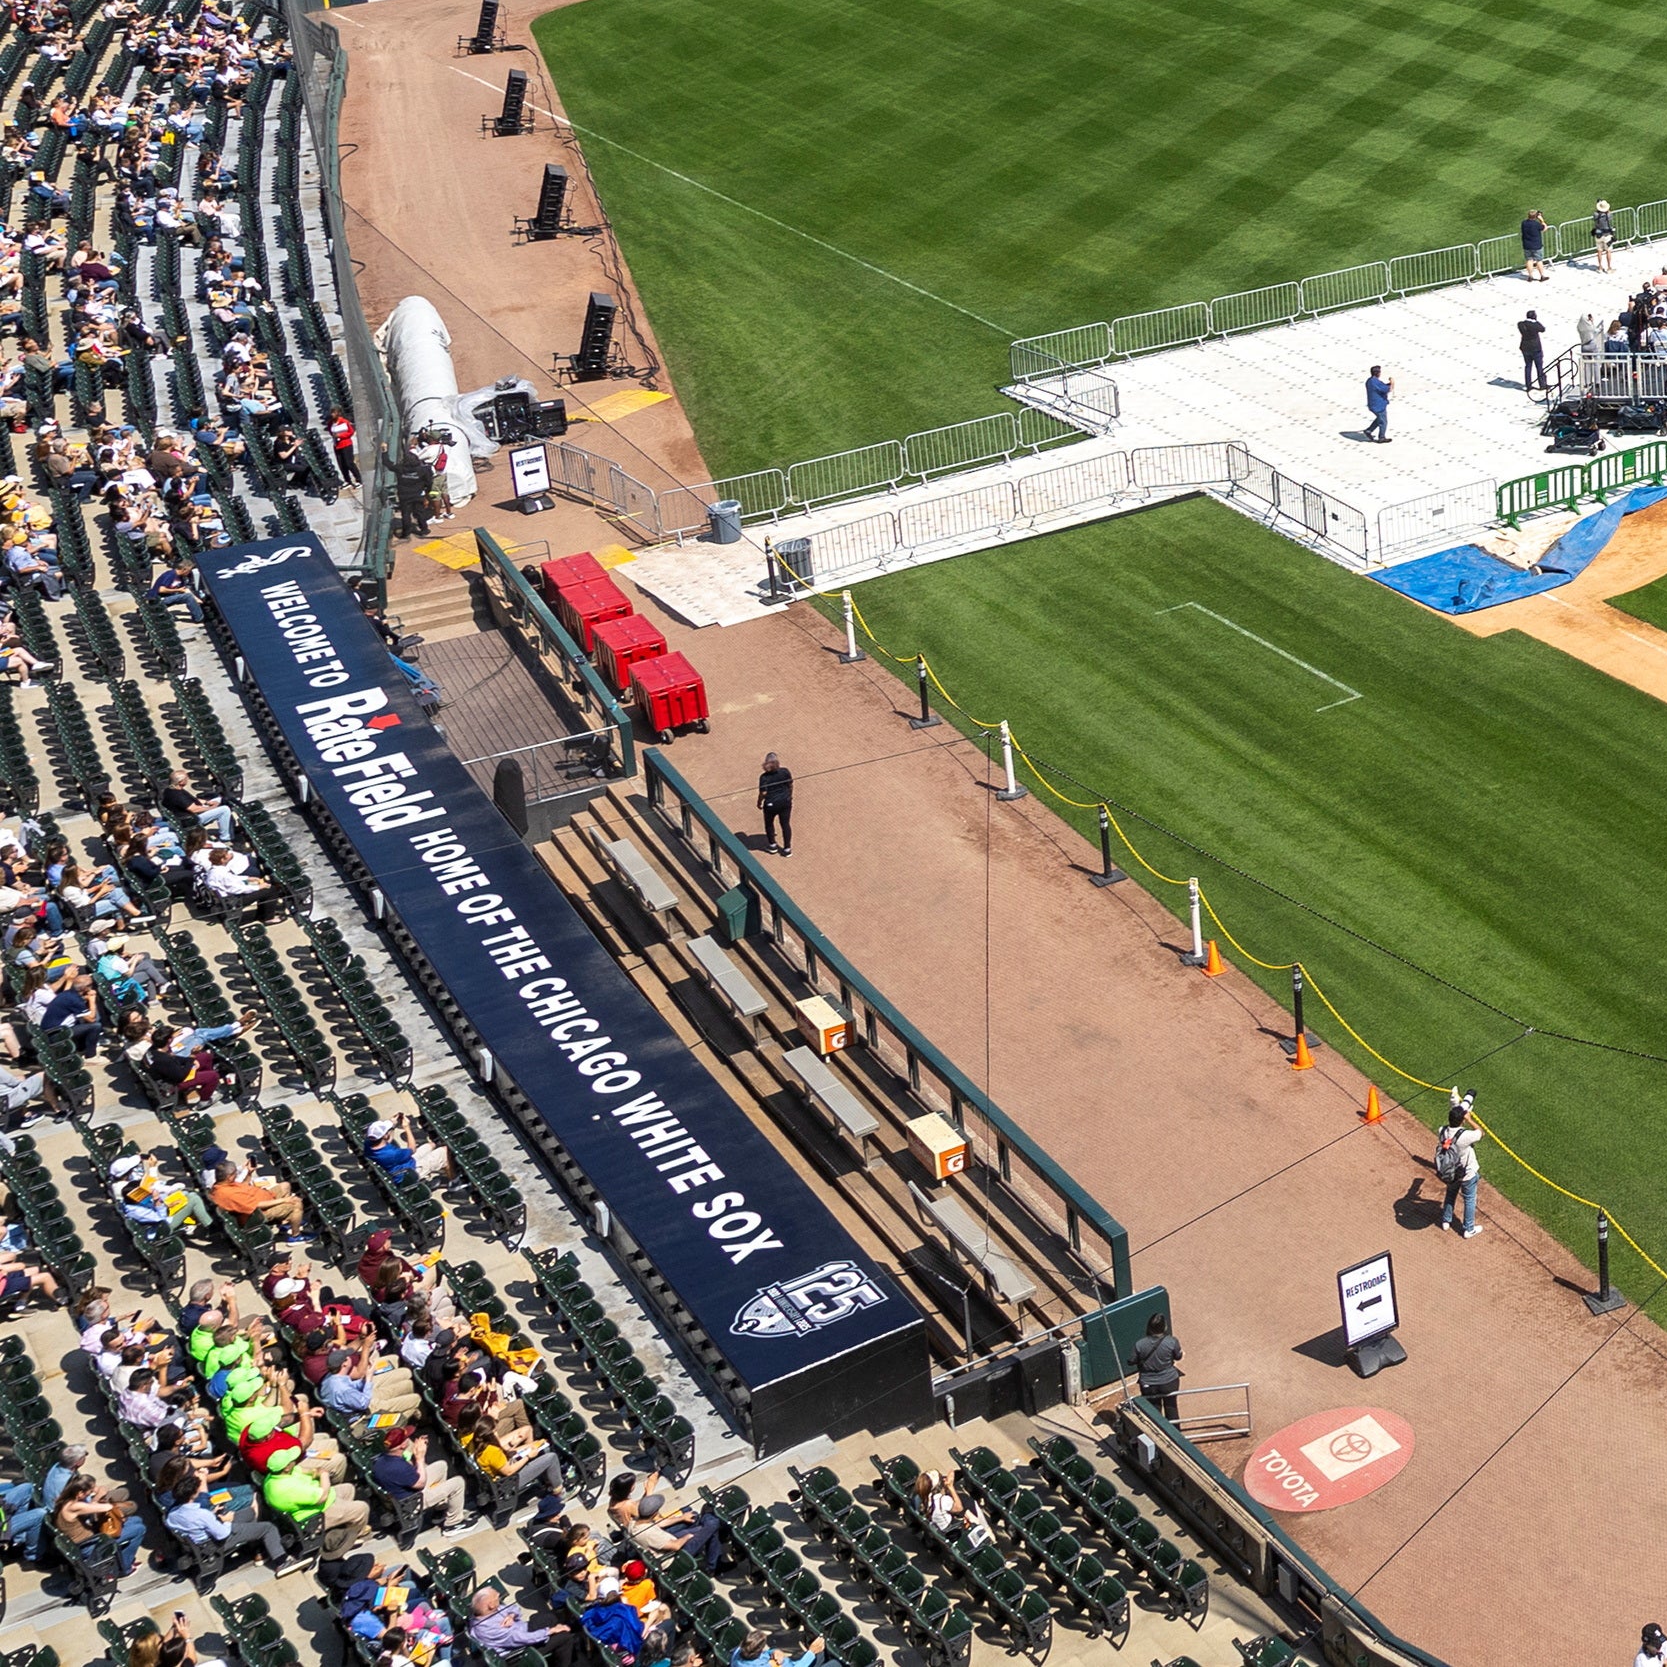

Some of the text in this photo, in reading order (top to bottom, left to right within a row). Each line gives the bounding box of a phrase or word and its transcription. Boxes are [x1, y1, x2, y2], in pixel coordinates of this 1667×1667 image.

[260, 580, 350, 688] WELCOME TO
[296, 687, 447, 834] Rate Field
[410, 828, 784, 1265] HOME OF THE CHICAGO WHITE SOX
[778, 1262, 884, 1324] 125
[1345, 1272, 1388, 1298] RESTROOMS
[1258, 1448, 1321, 1508] TOYOTA
